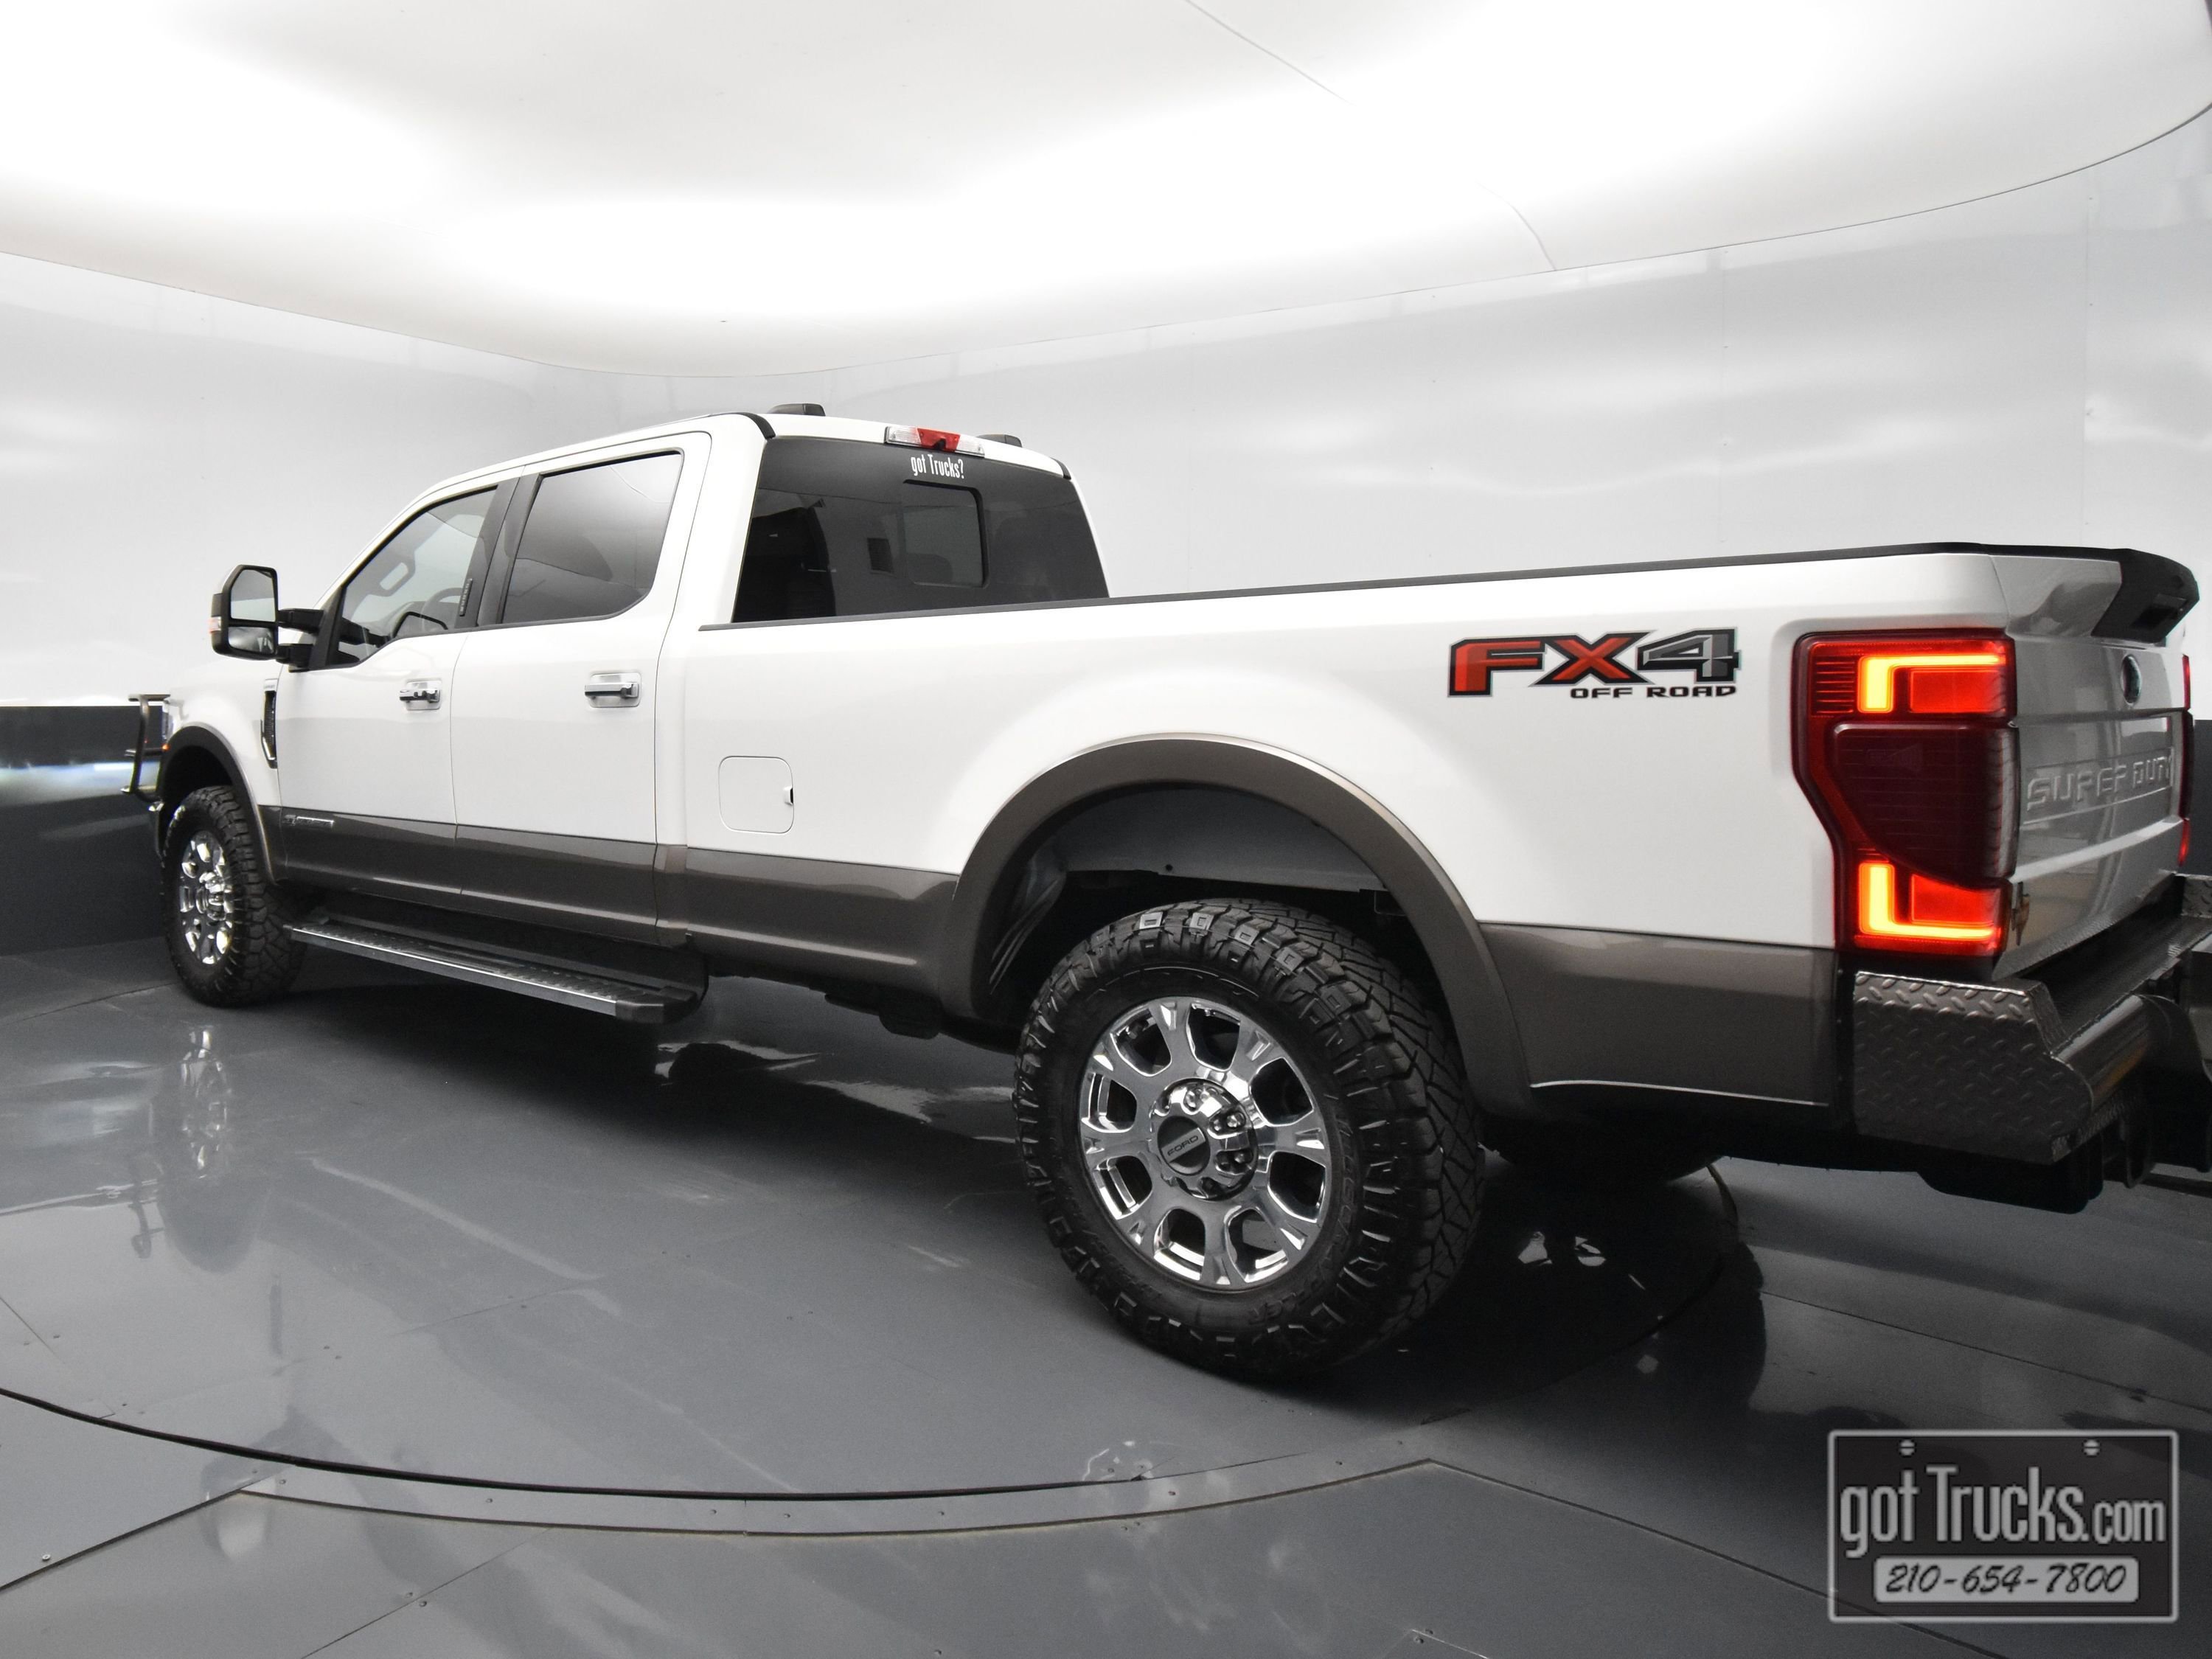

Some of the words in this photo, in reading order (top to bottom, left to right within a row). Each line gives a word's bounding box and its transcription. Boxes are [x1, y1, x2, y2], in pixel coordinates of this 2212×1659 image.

[911, 454, 927, 476] got
[928, 453, 965, 479] Trucks?
[1447, 627, 1742, 698] FX4
[1571, 686, 1633, 700] OFF
[1646, 685, 1737, 699] ROAD
[1167, 1135, 1199, 1156] FORD
